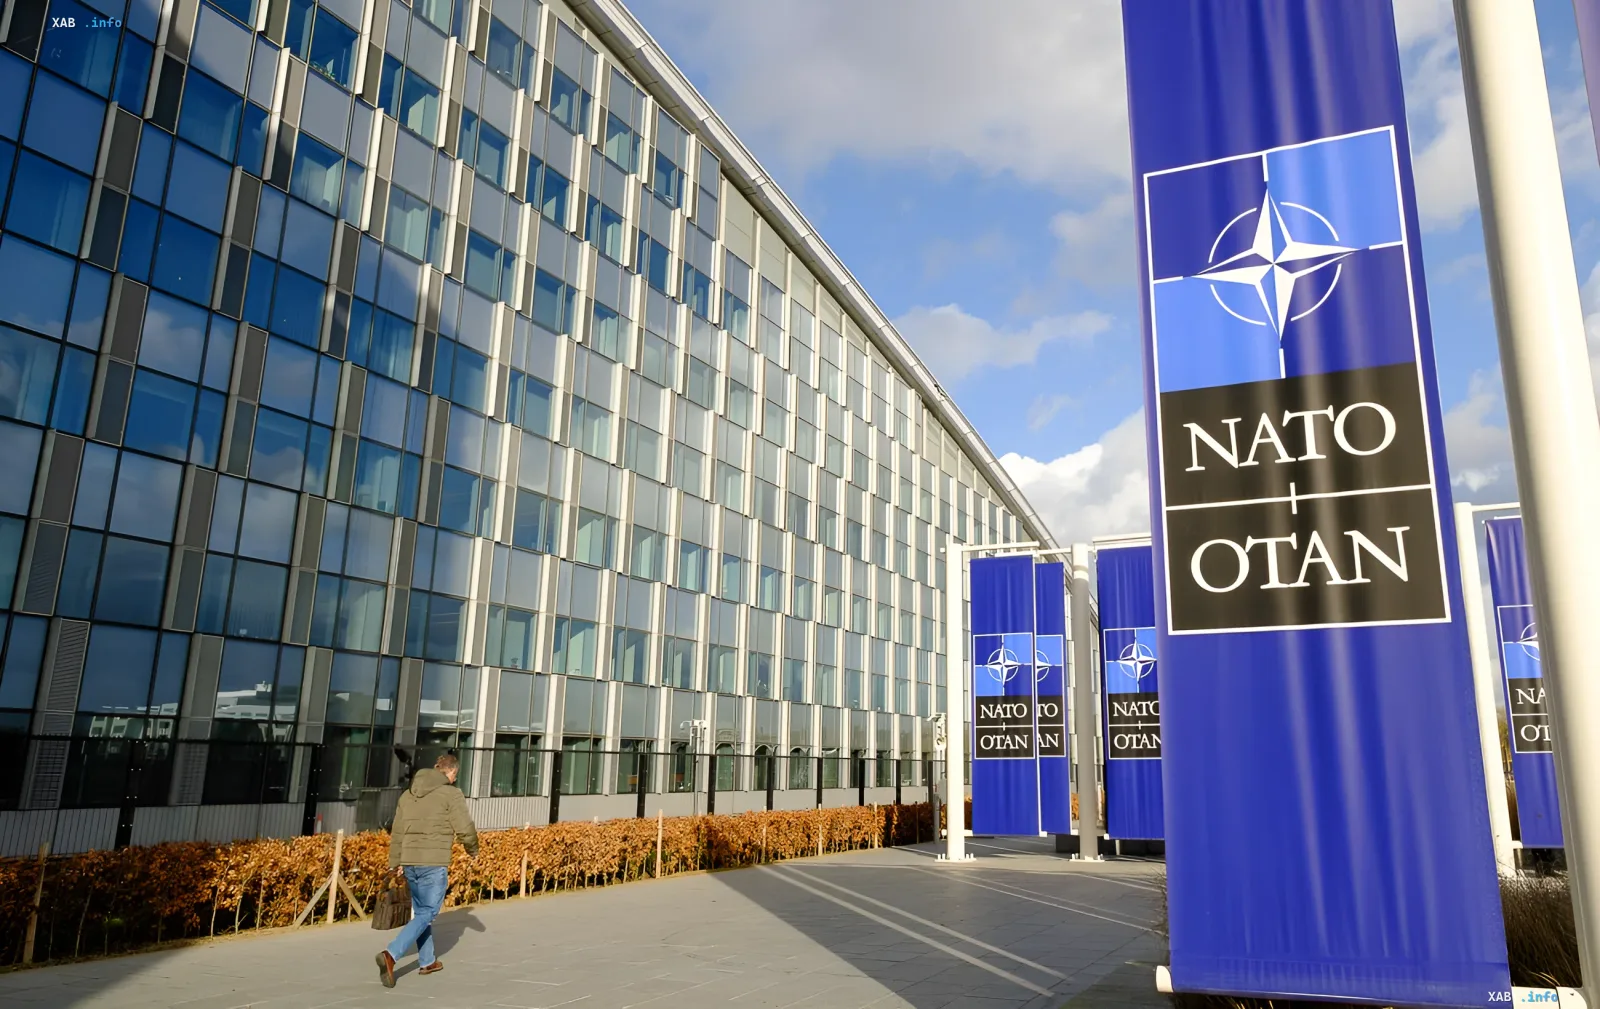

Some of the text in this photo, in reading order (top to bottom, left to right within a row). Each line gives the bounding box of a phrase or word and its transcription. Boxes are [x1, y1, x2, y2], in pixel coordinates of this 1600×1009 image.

[1183, 402, 1396, 471] NATO
[1191, 526, 1410, 593] OTAN
[1515, 687, 1546, 704] NA
[980, 703, 1028, 718] NATO
[1038, 702, 1058, 718] TO
[1038, 732, 1059, 748] AN
[1520, 724, 1551, 741] OT
[980, 734, 1029, 750] OTAN
